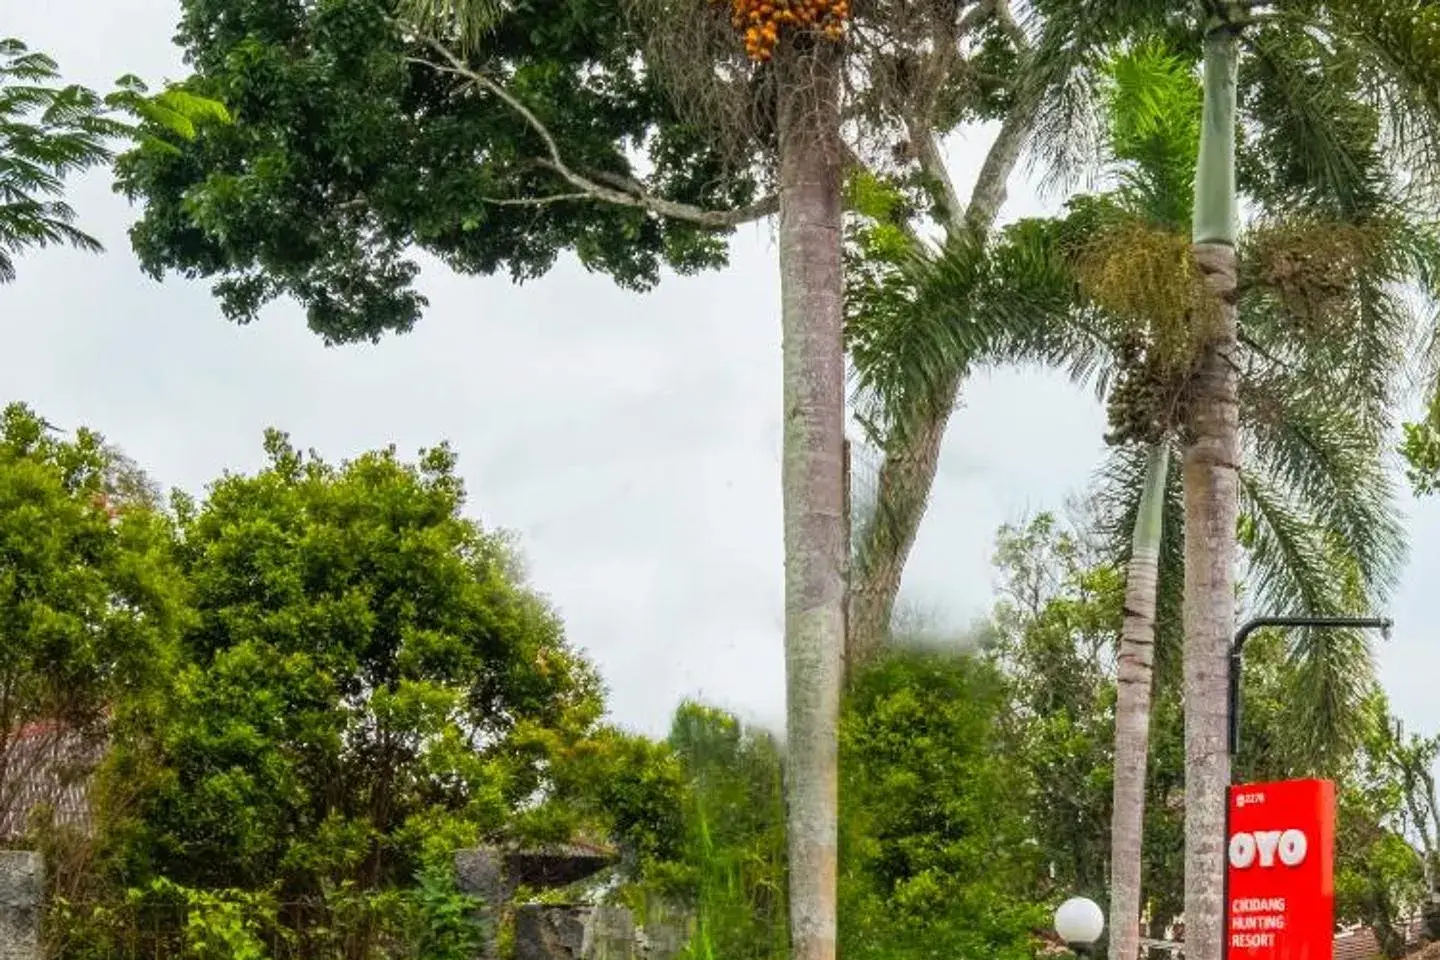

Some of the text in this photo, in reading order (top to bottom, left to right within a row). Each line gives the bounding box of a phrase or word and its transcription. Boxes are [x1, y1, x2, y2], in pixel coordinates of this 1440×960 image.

[1229, 829, 1307, 868] OYO
[1232, 915, 1284, 930] HUNTING
[1232, 933, 1275, 948] RESORT
